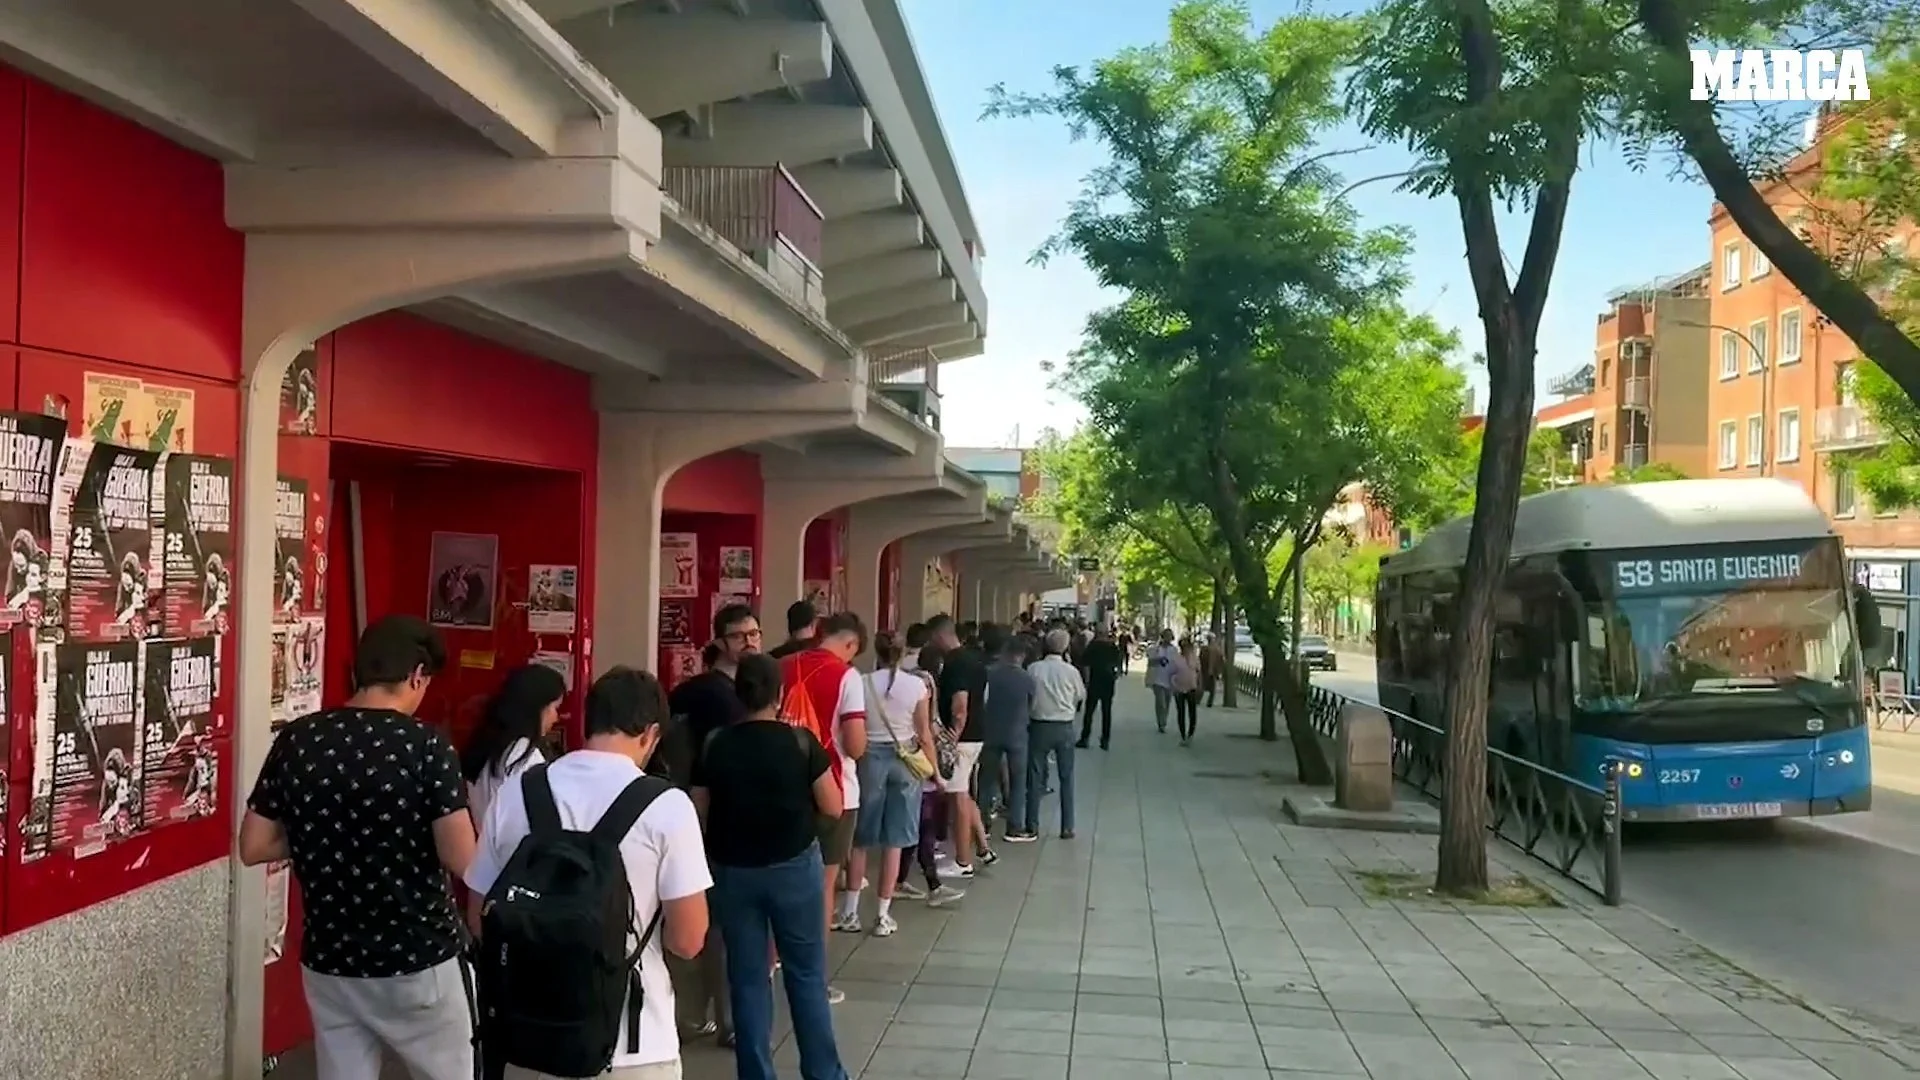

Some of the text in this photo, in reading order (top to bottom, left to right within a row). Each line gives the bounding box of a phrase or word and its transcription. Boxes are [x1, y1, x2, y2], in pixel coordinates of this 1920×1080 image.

[104, 466, 149, 501] GUERRA
[190, 474, 230, 505] GUERRA
[73, 526, 92, 548] 25
[167, 533, 183, 552] 25
[1618, 554, 1801, 587] 58 SANTA EUGENIA
[86, 661, 133, 697] GUERRA
[171, 656, 211, 690] GUERRA
[57, 732, 76, 754] 25
[146, 721, 163, 743] 25
